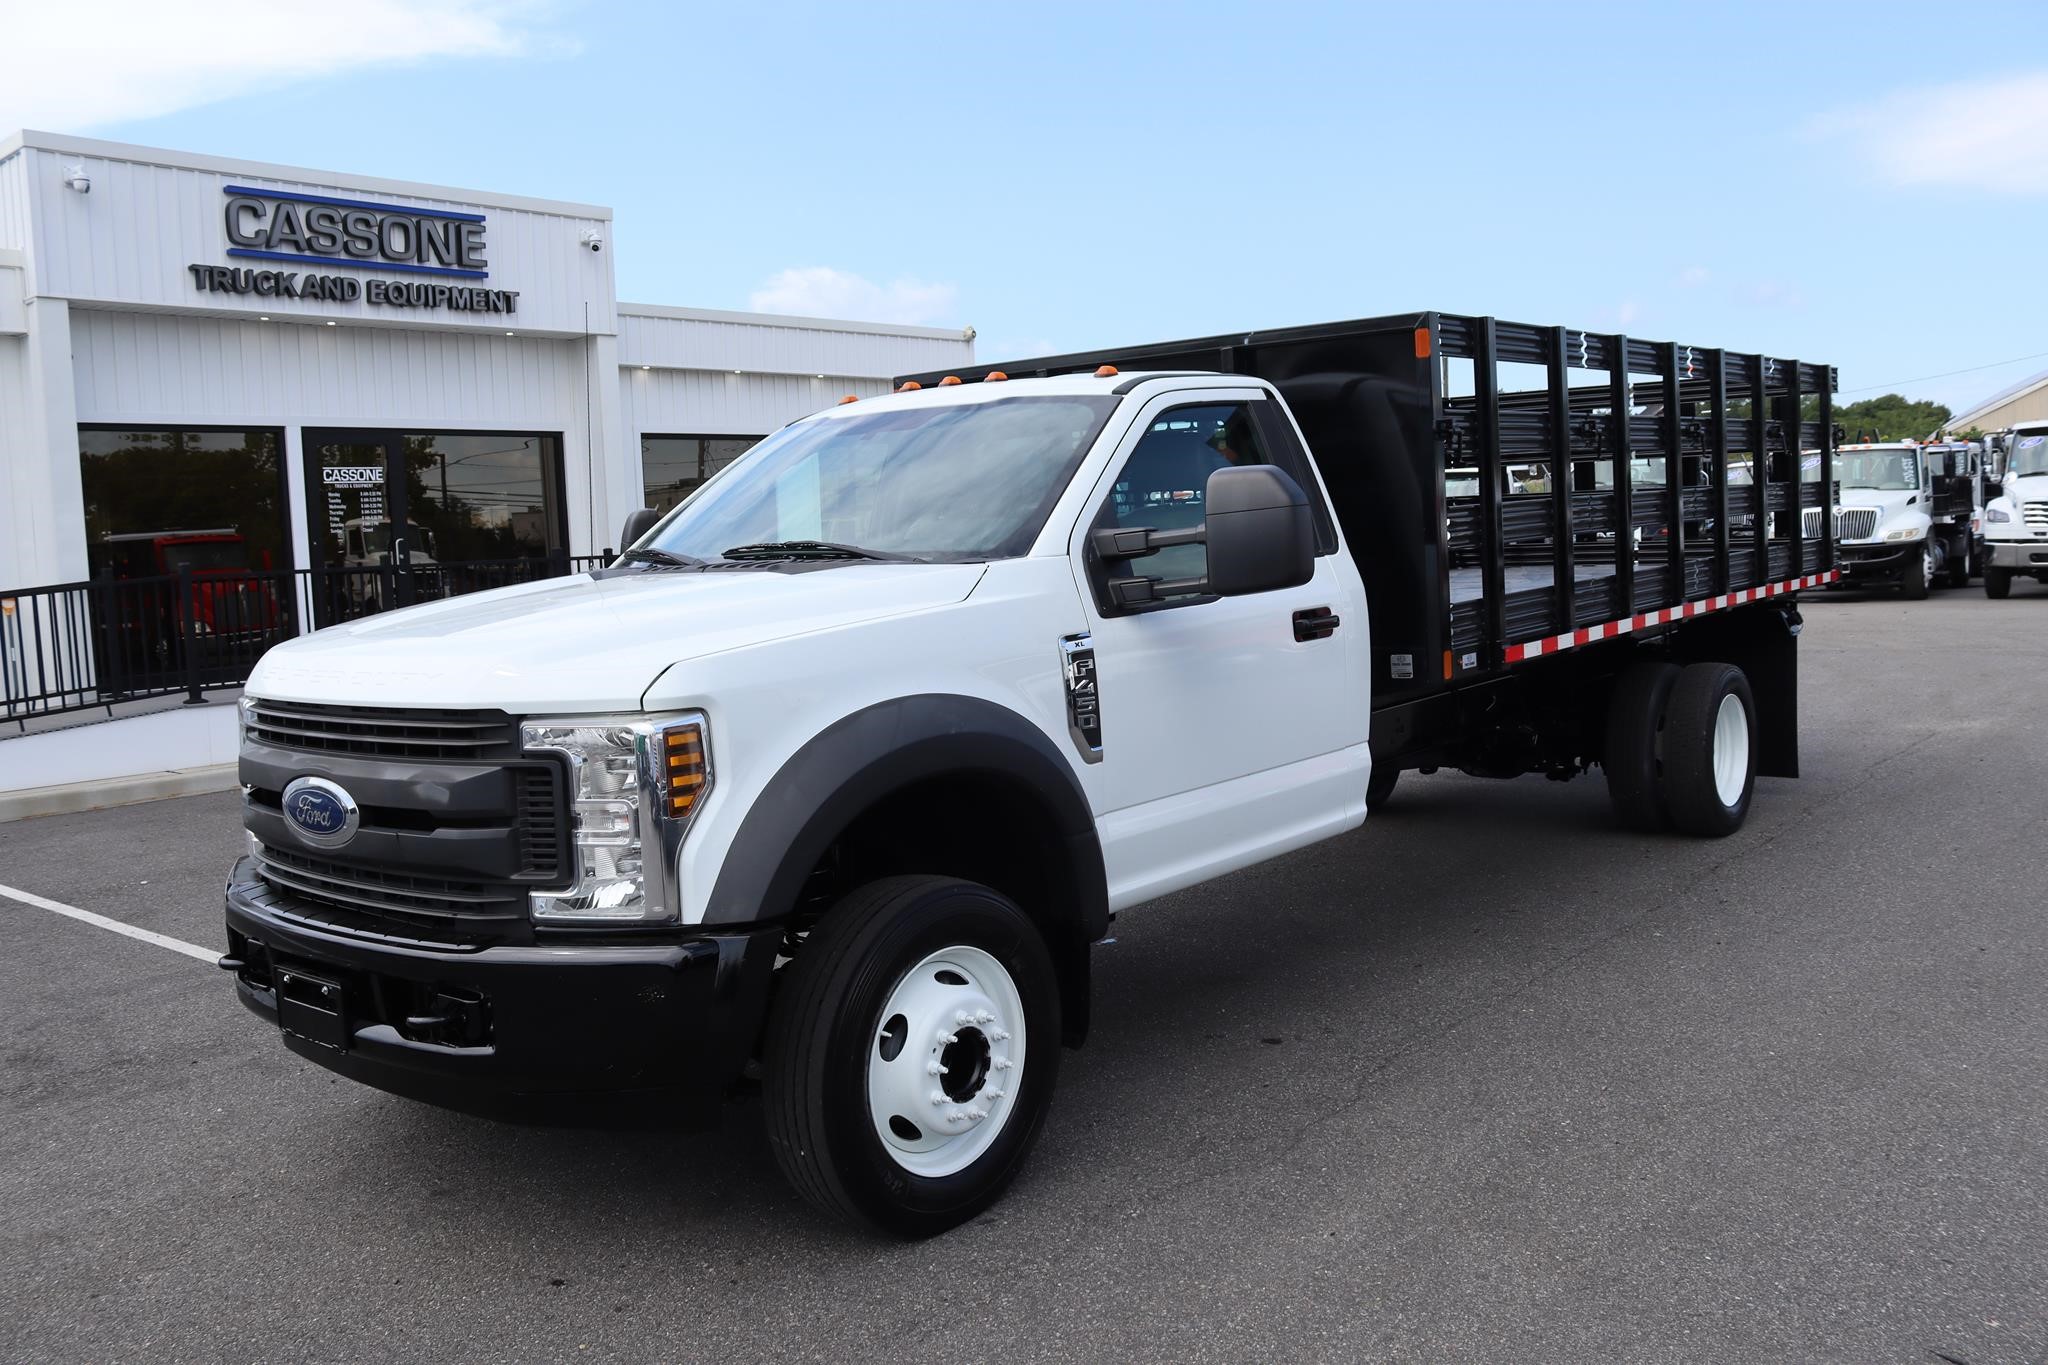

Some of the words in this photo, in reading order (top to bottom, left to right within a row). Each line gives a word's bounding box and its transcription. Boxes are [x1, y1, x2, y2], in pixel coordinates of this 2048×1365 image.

[225, 197, 488, 268] CASSONE
[189, 263, 299, 297] TRUCK
[298, 273, 361, 301] AND
[366, 279, 520, 314] EQUIPMENT
[323, 469, 383, 481] CASSONE
[296, 794, 332, 827] Ford
